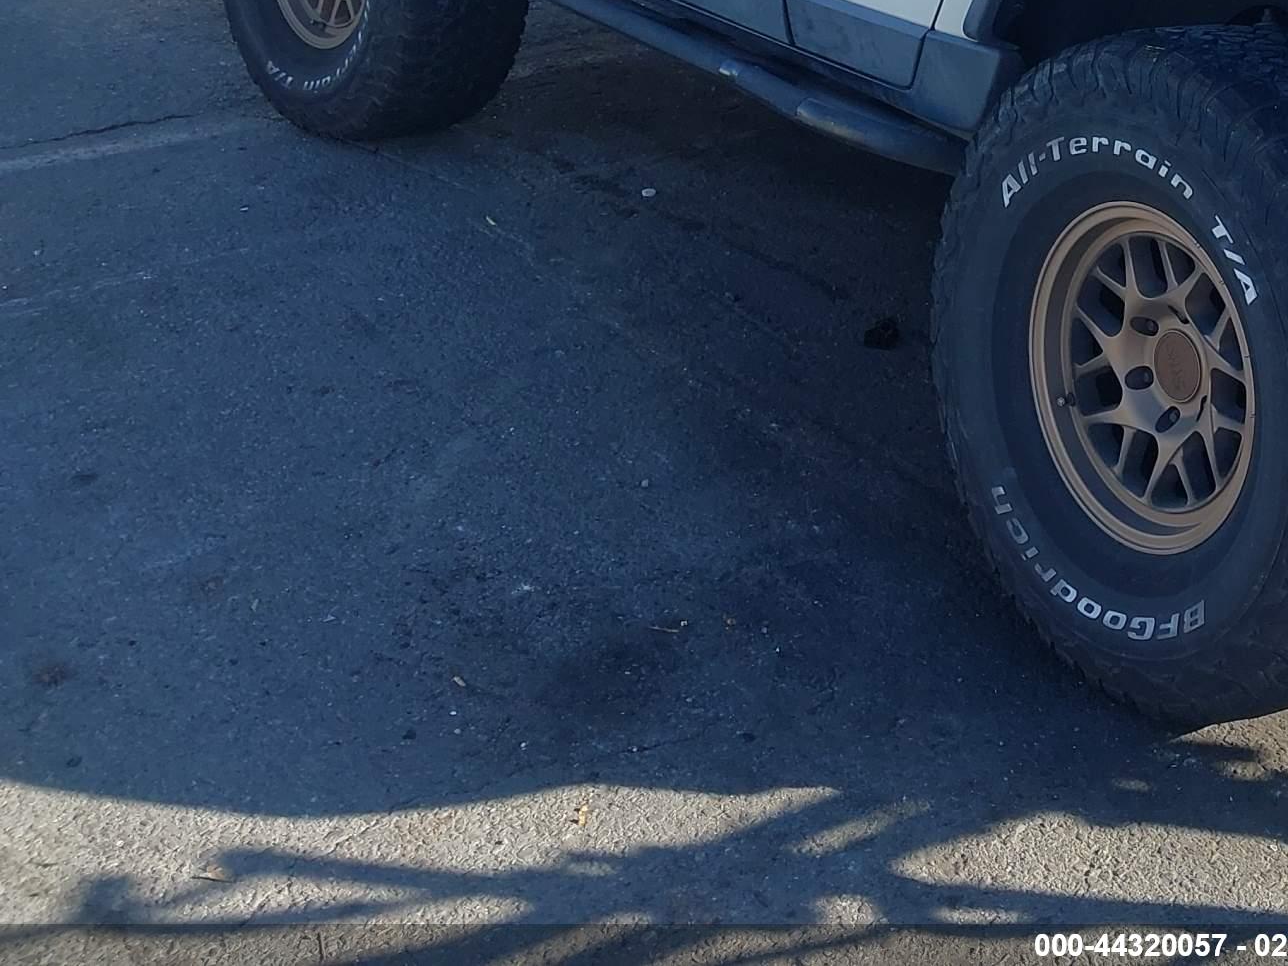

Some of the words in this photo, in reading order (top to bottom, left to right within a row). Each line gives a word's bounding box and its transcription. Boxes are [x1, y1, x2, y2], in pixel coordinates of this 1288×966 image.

[1001, 135, 1194, 208] All-Terrain
[1210, 215, 1256, 305] T/A
[991, 484, 1206, 641] BFGoodrich
